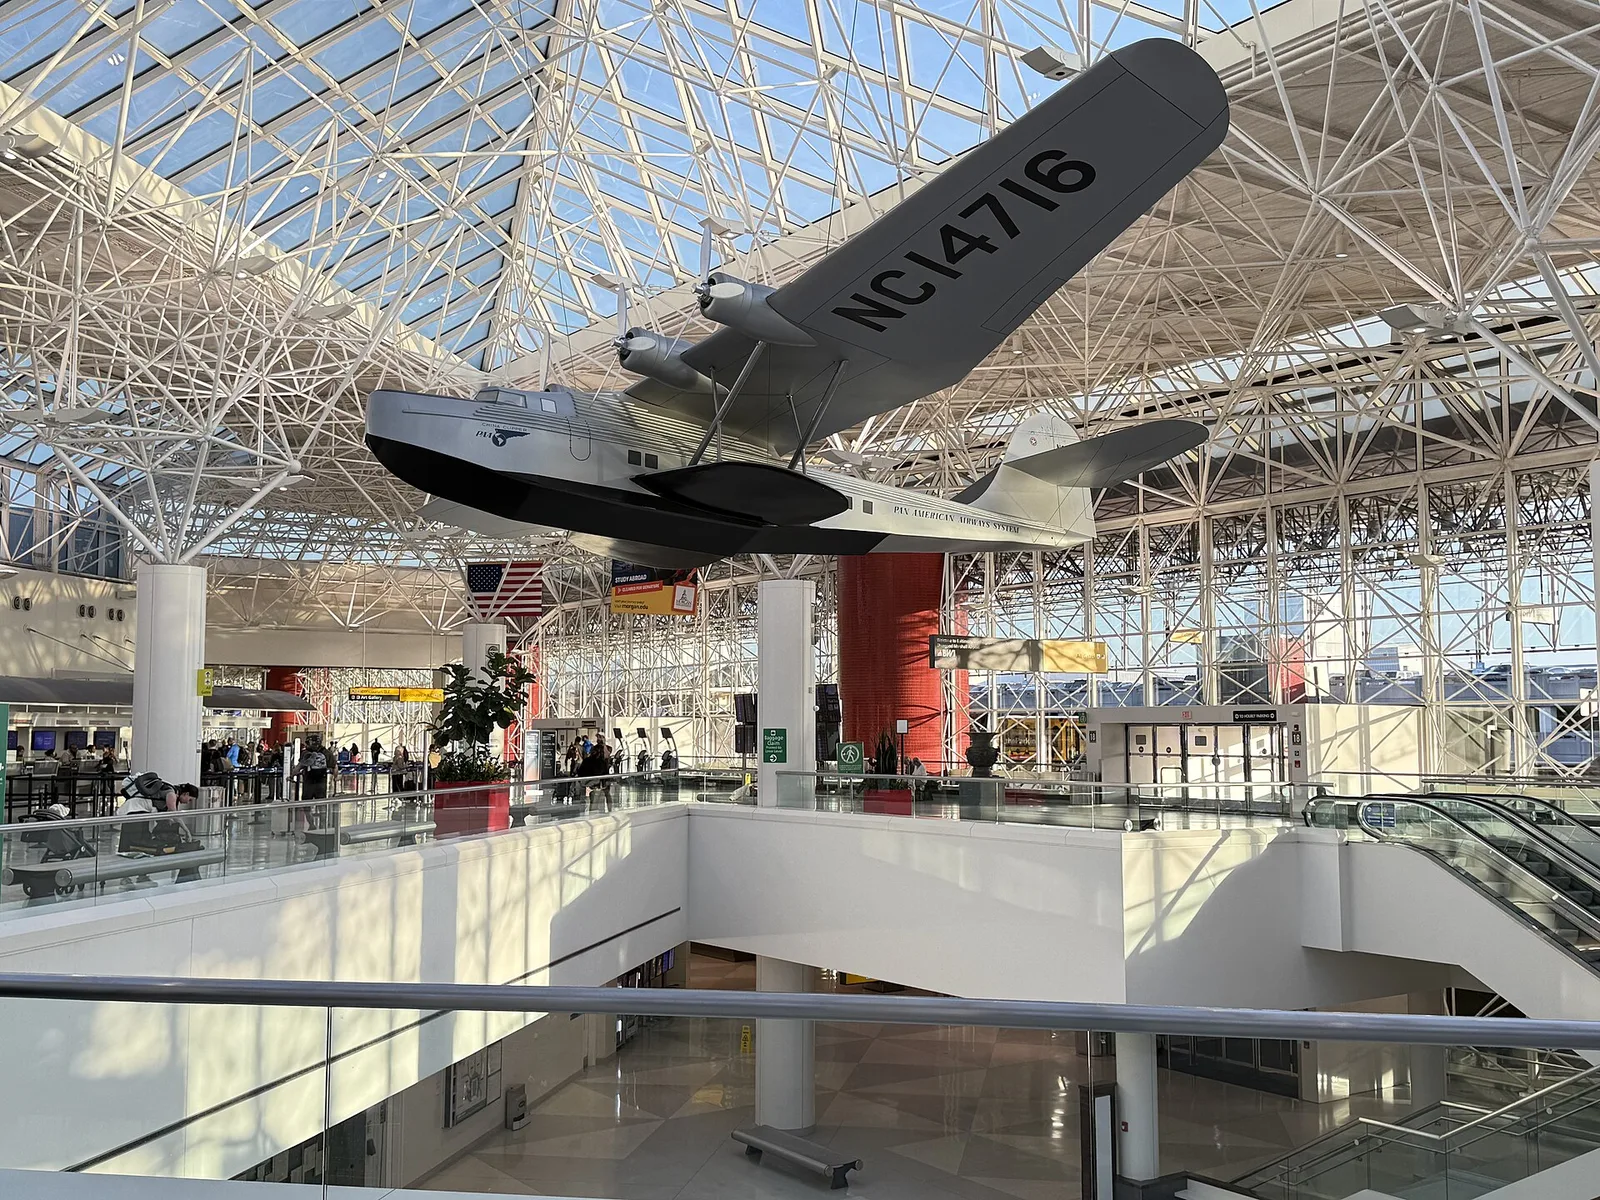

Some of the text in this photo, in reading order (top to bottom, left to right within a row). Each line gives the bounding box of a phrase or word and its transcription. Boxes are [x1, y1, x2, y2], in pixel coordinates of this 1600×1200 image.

[831, 149, 1096, 333] NC14716
[893, 505, 1020, 534] PAN AMERICAN AIRWAYS SYSTEM
[615, 574, 647, 584] STUDY ABROAD
[943, 649, 956, 657] BWI
